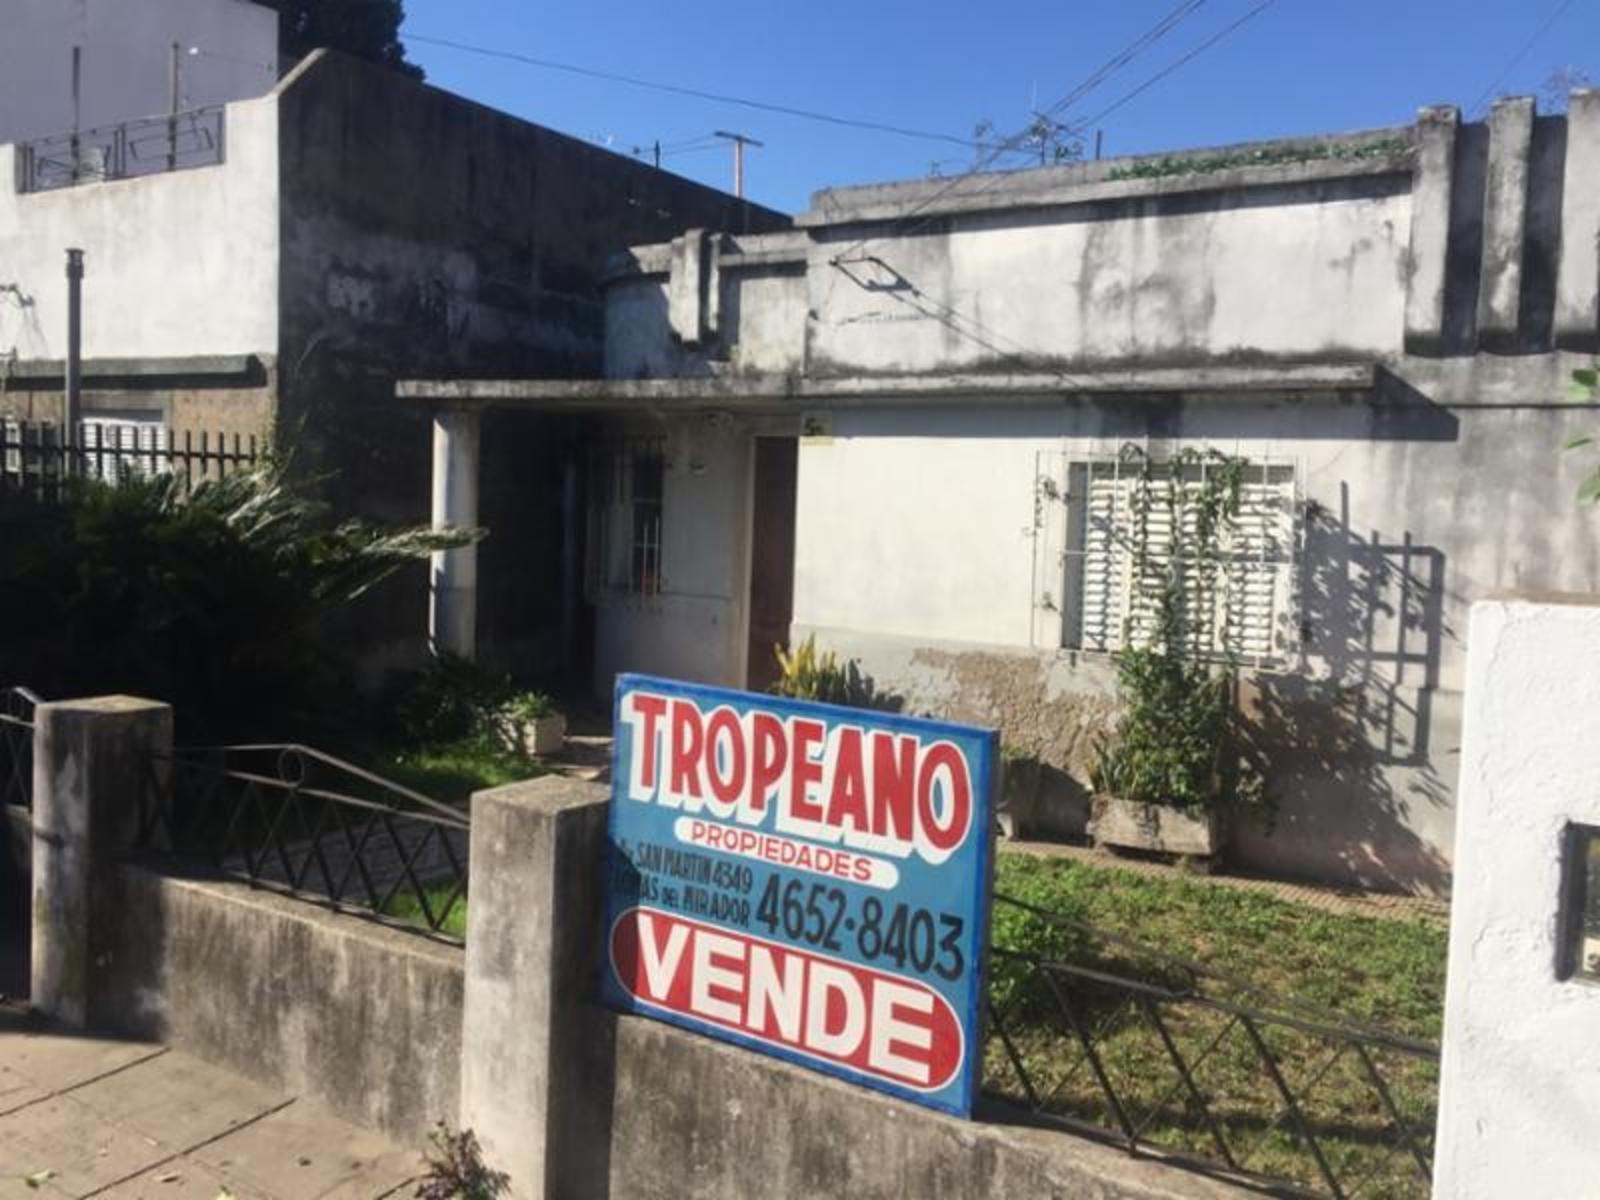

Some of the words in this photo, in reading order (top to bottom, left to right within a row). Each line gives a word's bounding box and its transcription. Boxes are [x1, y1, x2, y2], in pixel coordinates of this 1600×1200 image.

[630, 692, 971, 853] TROPEANO
[690, 820, 873, 882] PROPIEDADES
[684, 885, 751, 929] MIRADOR
[636, 913, 934, 1084] VENDE
